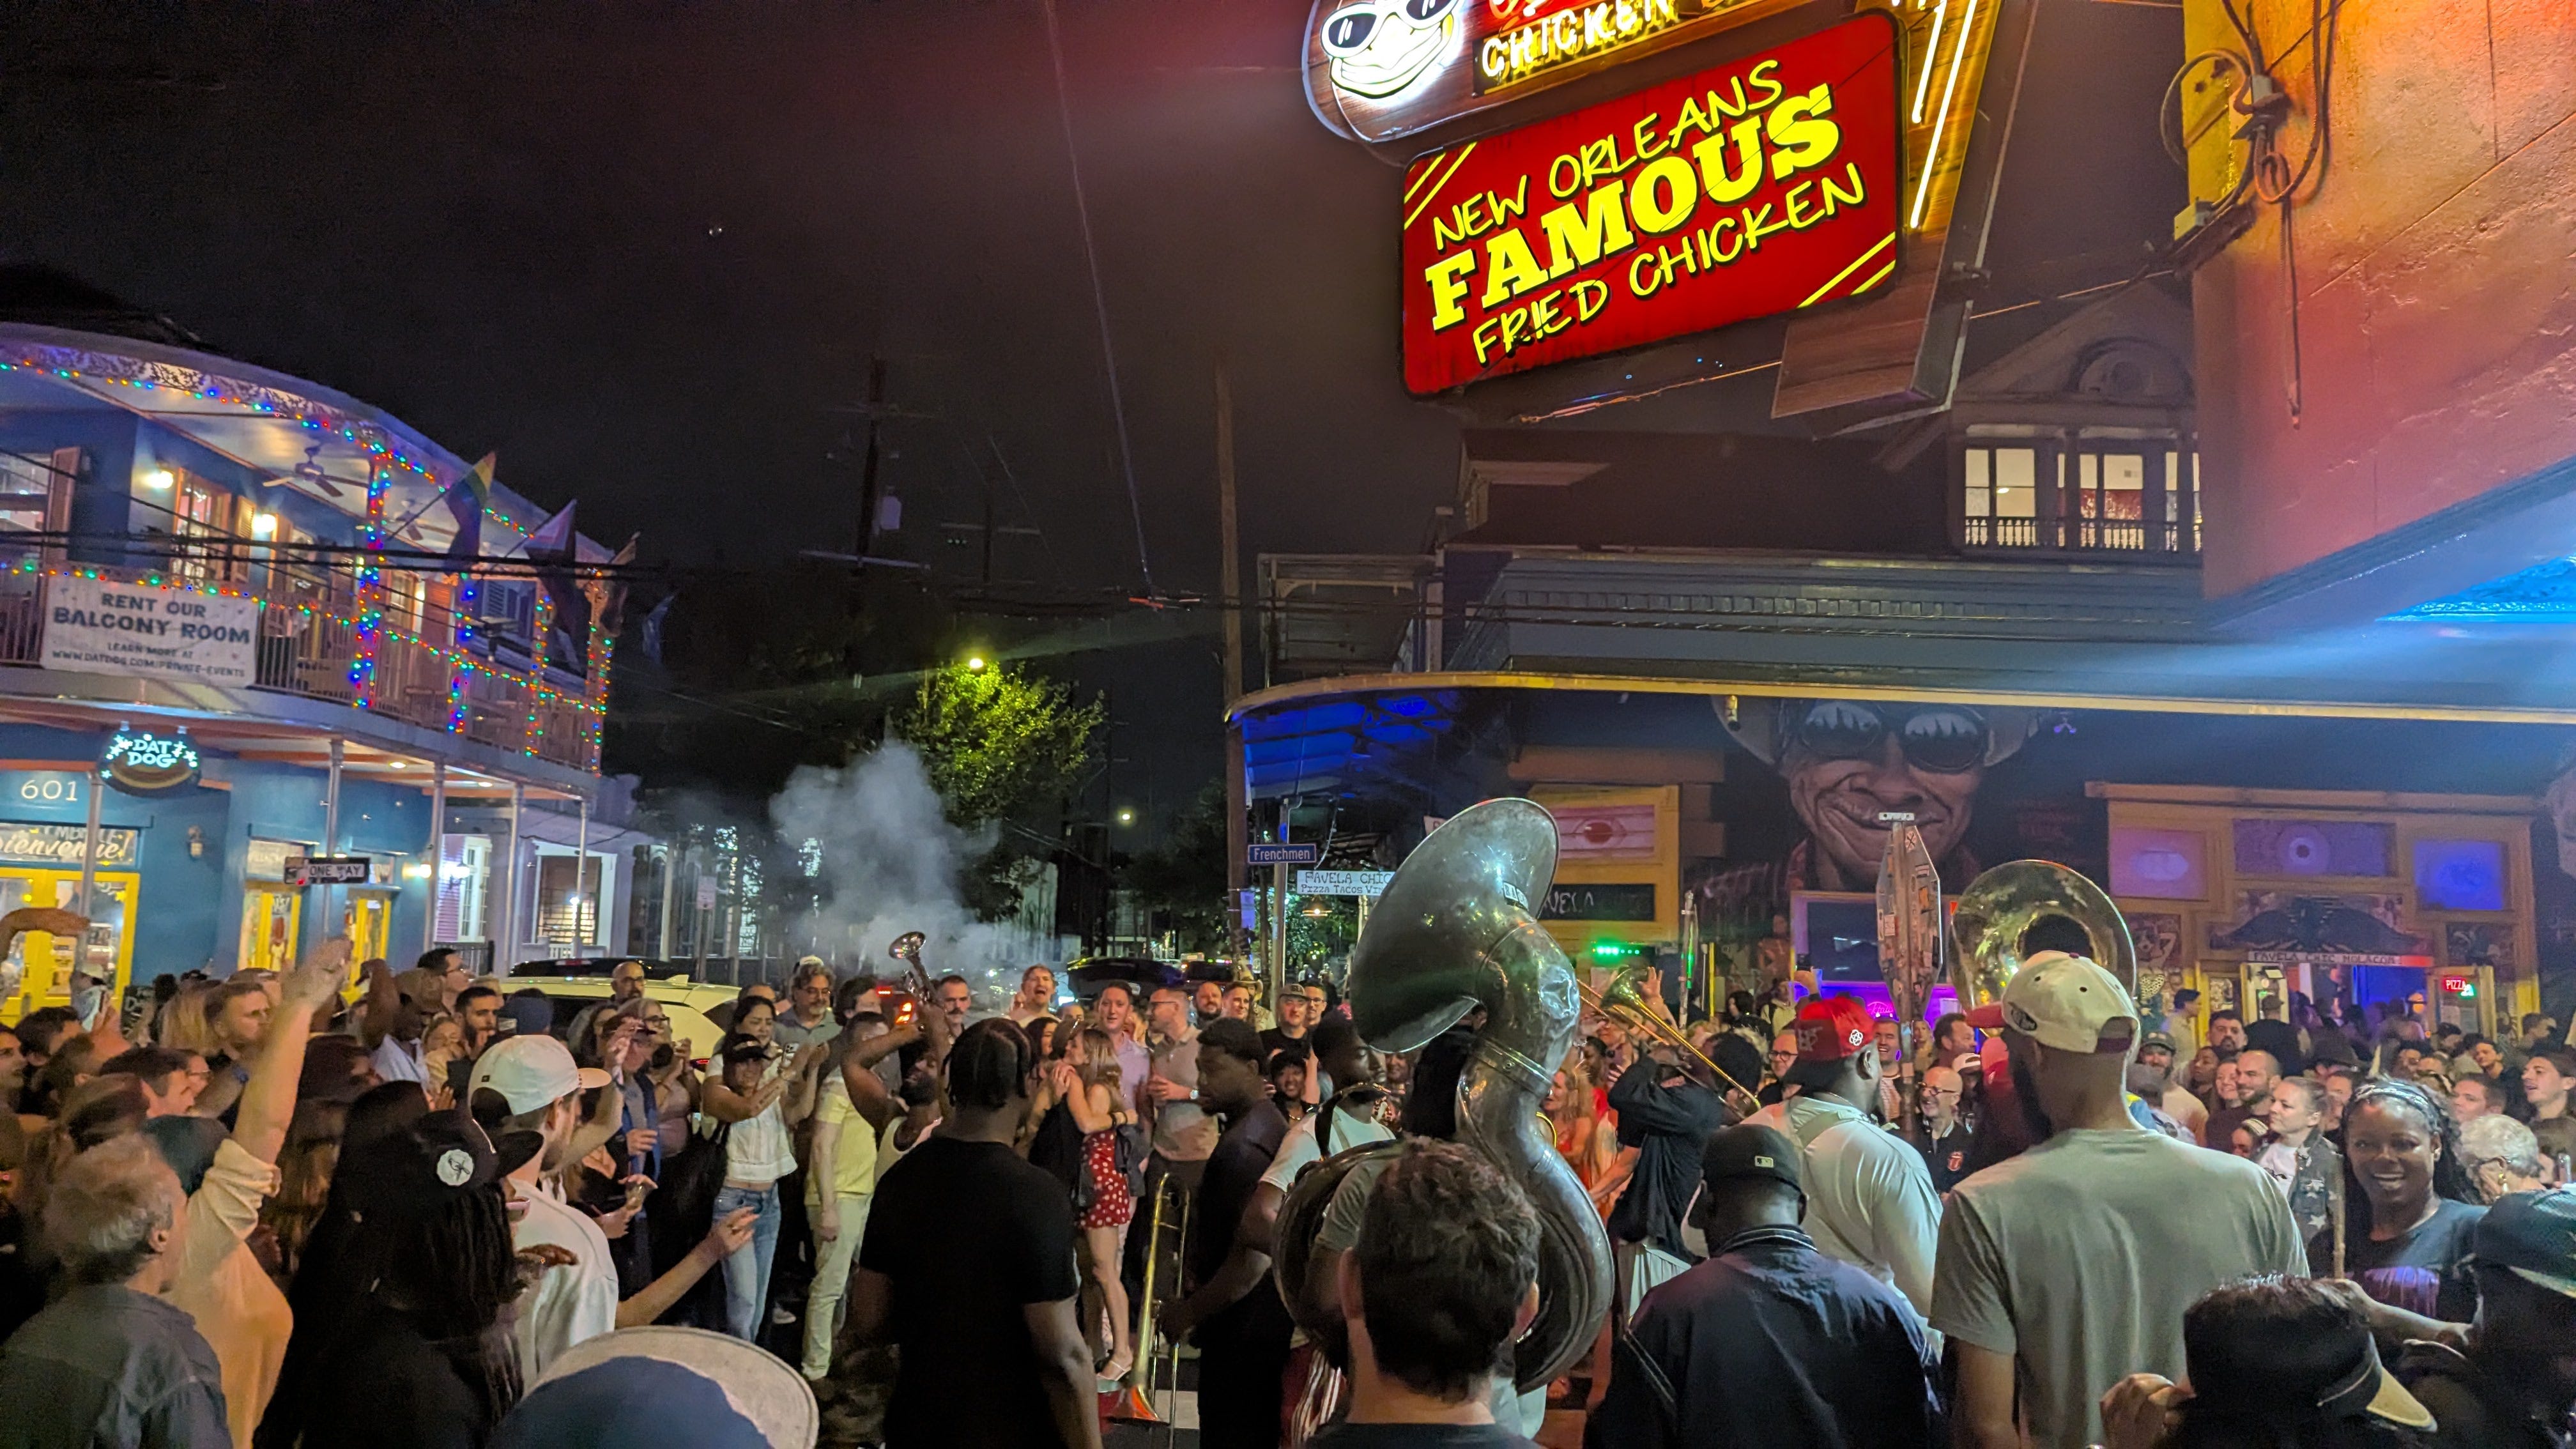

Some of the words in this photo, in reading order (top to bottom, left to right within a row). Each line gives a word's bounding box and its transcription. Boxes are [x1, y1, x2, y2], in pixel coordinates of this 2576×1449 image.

[1482, 0, 1678, 77] CHICKEN
[1433, 175, 1529, 250] NEW
[1549, 59, 1784, 197] ORLEANS
[1425, 83, 1840, 331] FAMOUS
[1472, 279, 1609, 364] FRIED
[1629, 162, 1866, 297] CHICKEN
[102, 592, 158, 612] RENT
[166, 601, 206, 618] OUR
[54, 607, 171, 636] BALCONY
[181, 622, 250, 644] ROOM
[108, 642, 142, 654] LEARN
[146, 646, 178, 657] MORE
[181, 650, 194, 659] AT
[132, 739, 172, 755] DAT
[127, 752, 177, 768] DOG
[21, 779, 78, 801] 601
[1254, 848, 1310, 861] Frenchmen
[310, 866, 332, 876] ONE
[1305, 871, 1352, 884] FAVELA
[2254, 952, 2299, 962] FAVELA
[2446, 979, 2466, 990] PIZZA
